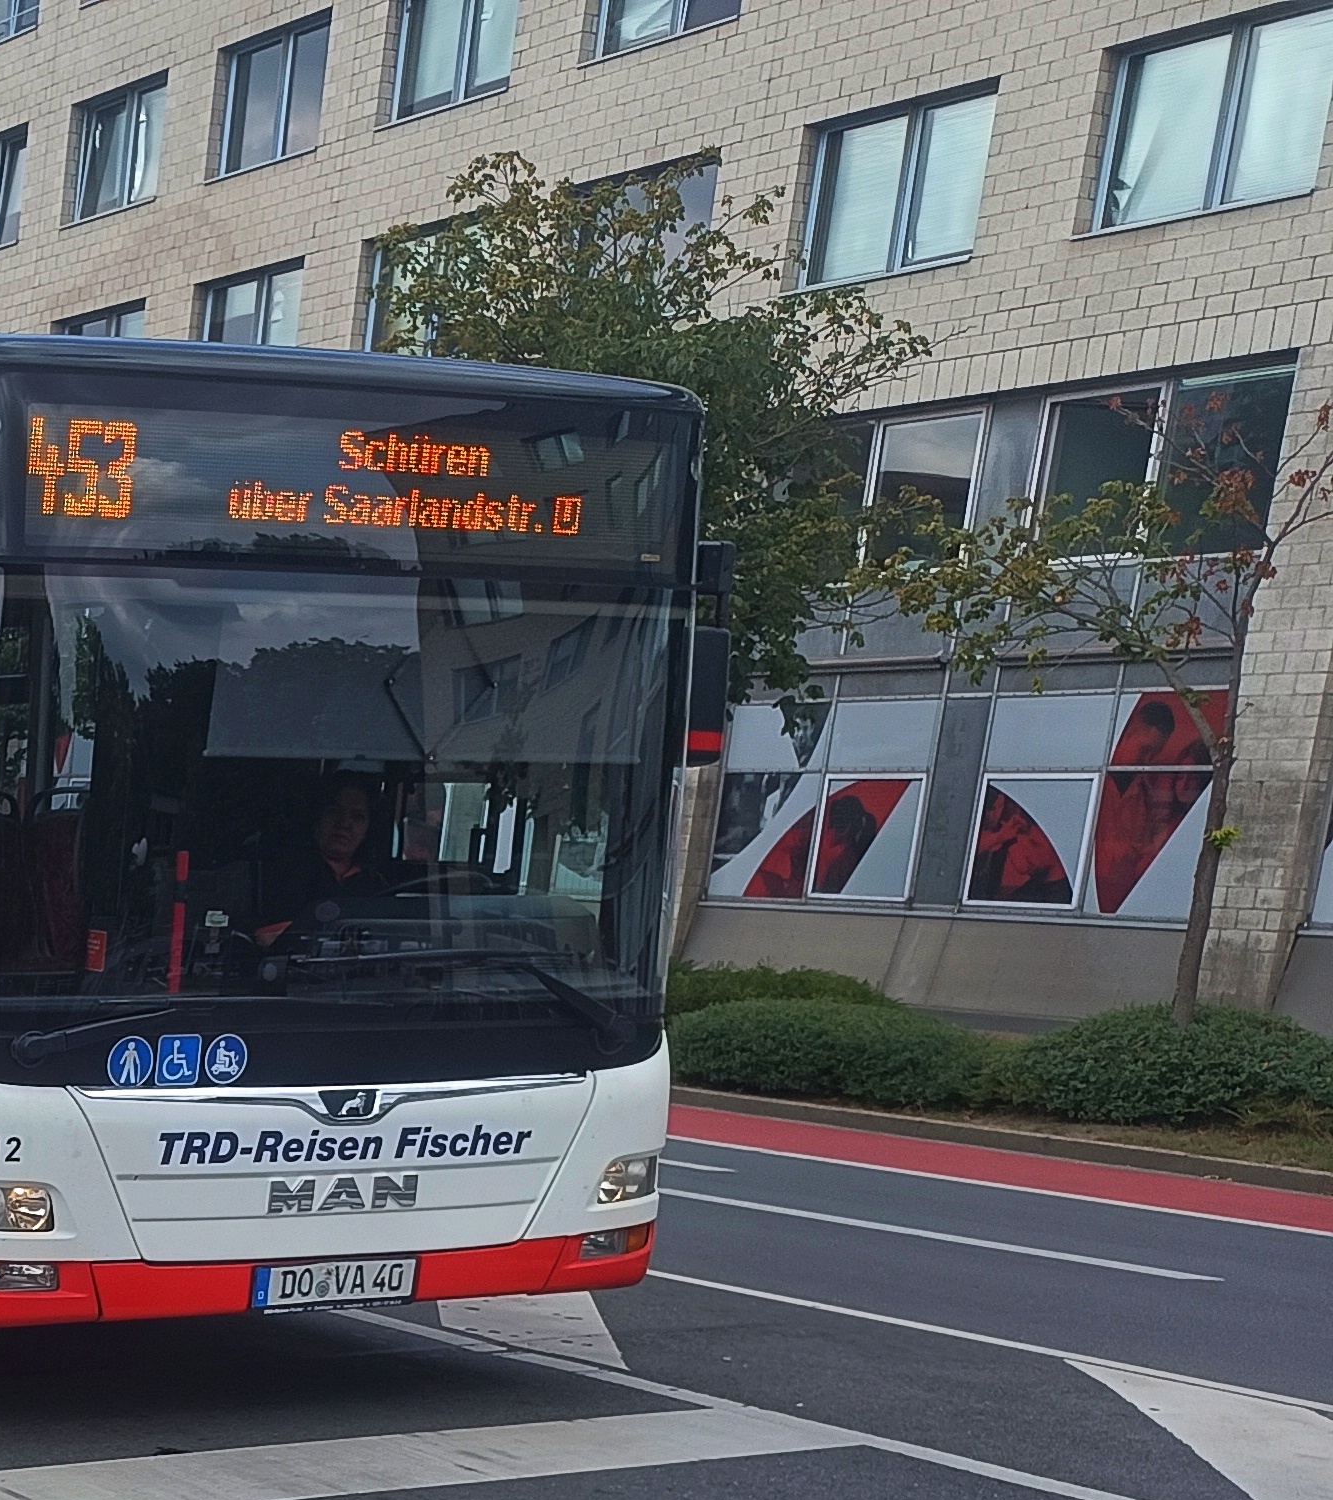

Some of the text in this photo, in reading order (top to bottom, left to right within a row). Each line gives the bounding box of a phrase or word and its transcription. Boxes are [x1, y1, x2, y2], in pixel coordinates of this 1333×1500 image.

[28, 417, 138, 518] 453
[339, 429, 491, 477] Schüren
[230, 481, 313, 522] über
[324, 484, 543, 533] Saarlandstr.
[158, 1125, 533, 1165] TRD-Reisen Fischer
[266, 1174, 419, 1215] MAN
[278, 1263, 404, 1299] DO VA 40
